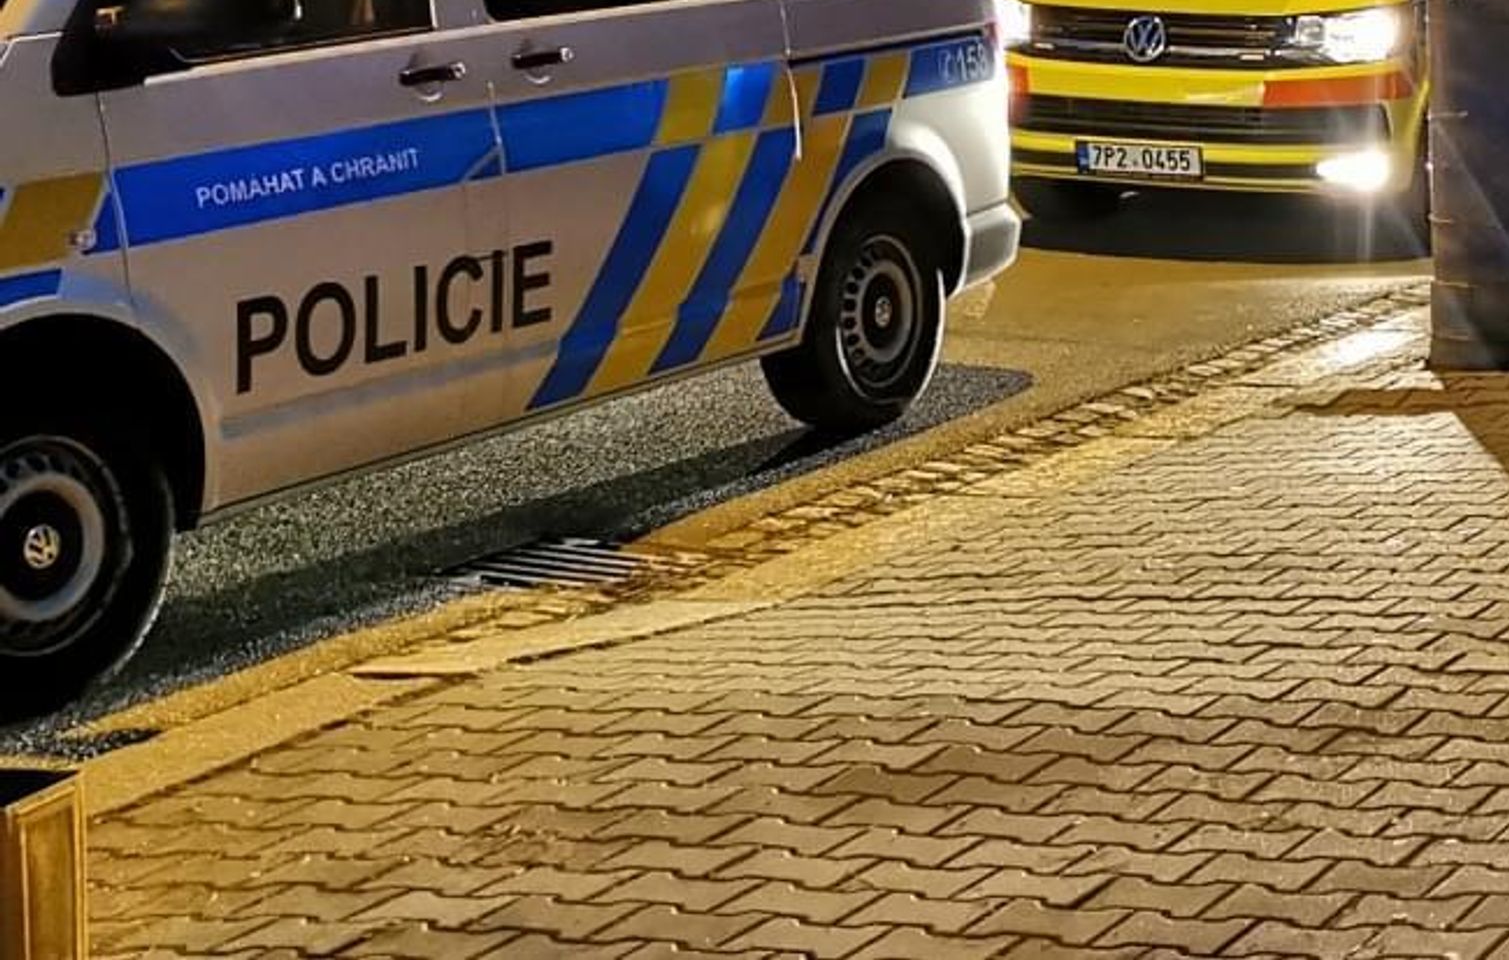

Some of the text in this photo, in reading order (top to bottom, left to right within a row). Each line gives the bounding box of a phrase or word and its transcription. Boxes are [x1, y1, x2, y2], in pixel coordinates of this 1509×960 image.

[1141, 149, 1191, 171] 0455
[311, 165, 327, 187] A
[235, 239, 553, 396] POLICIE
